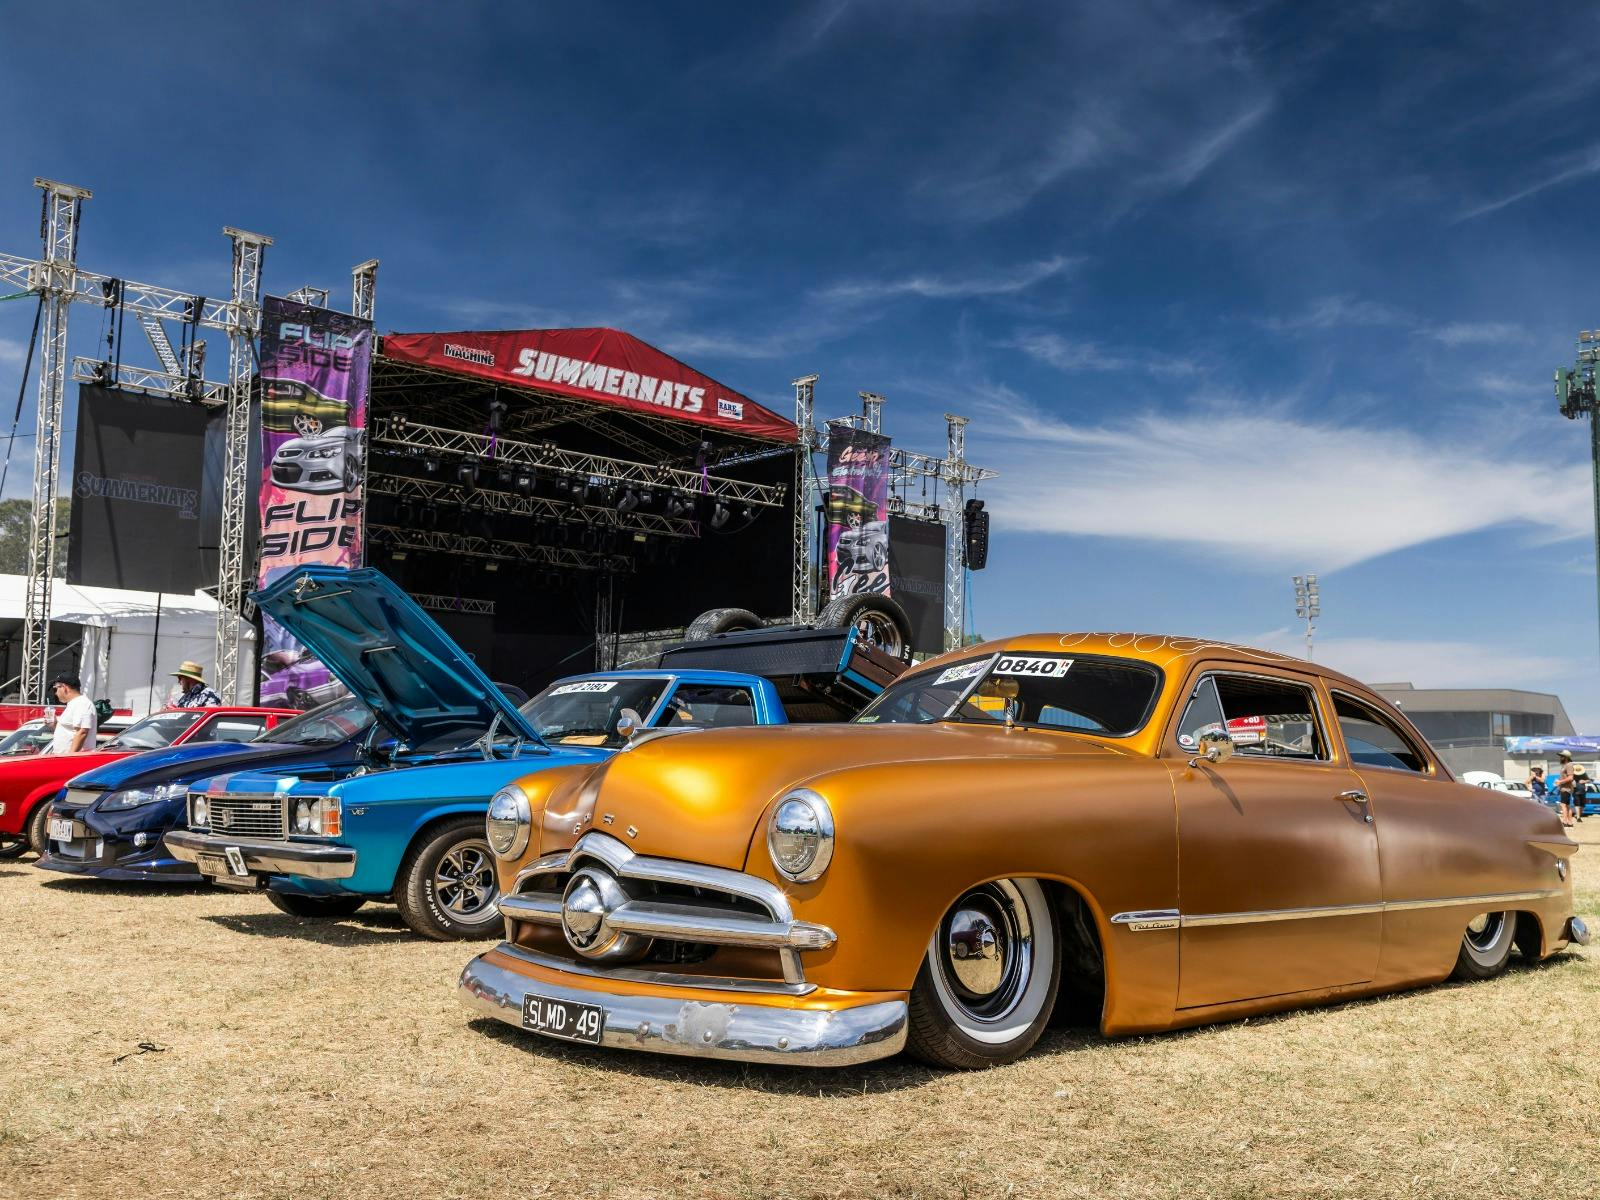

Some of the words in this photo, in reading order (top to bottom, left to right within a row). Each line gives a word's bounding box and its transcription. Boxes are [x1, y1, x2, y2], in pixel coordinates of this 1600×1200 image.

[279, 322, 353, 351] FLIP
[278, 344, 353, 373] SIDE
[444, 343, 495, 367] MACHINE
[511, 347, 706, 413] SUMMERNATS
[719, 401, 737, 412] RARE
[264, 498, 365, 529] FLIP
[260, 525, 356, 559] SIDE
[996, 659, 1058, 675] 0840
[425, 879, 451, 928] NANKANG
